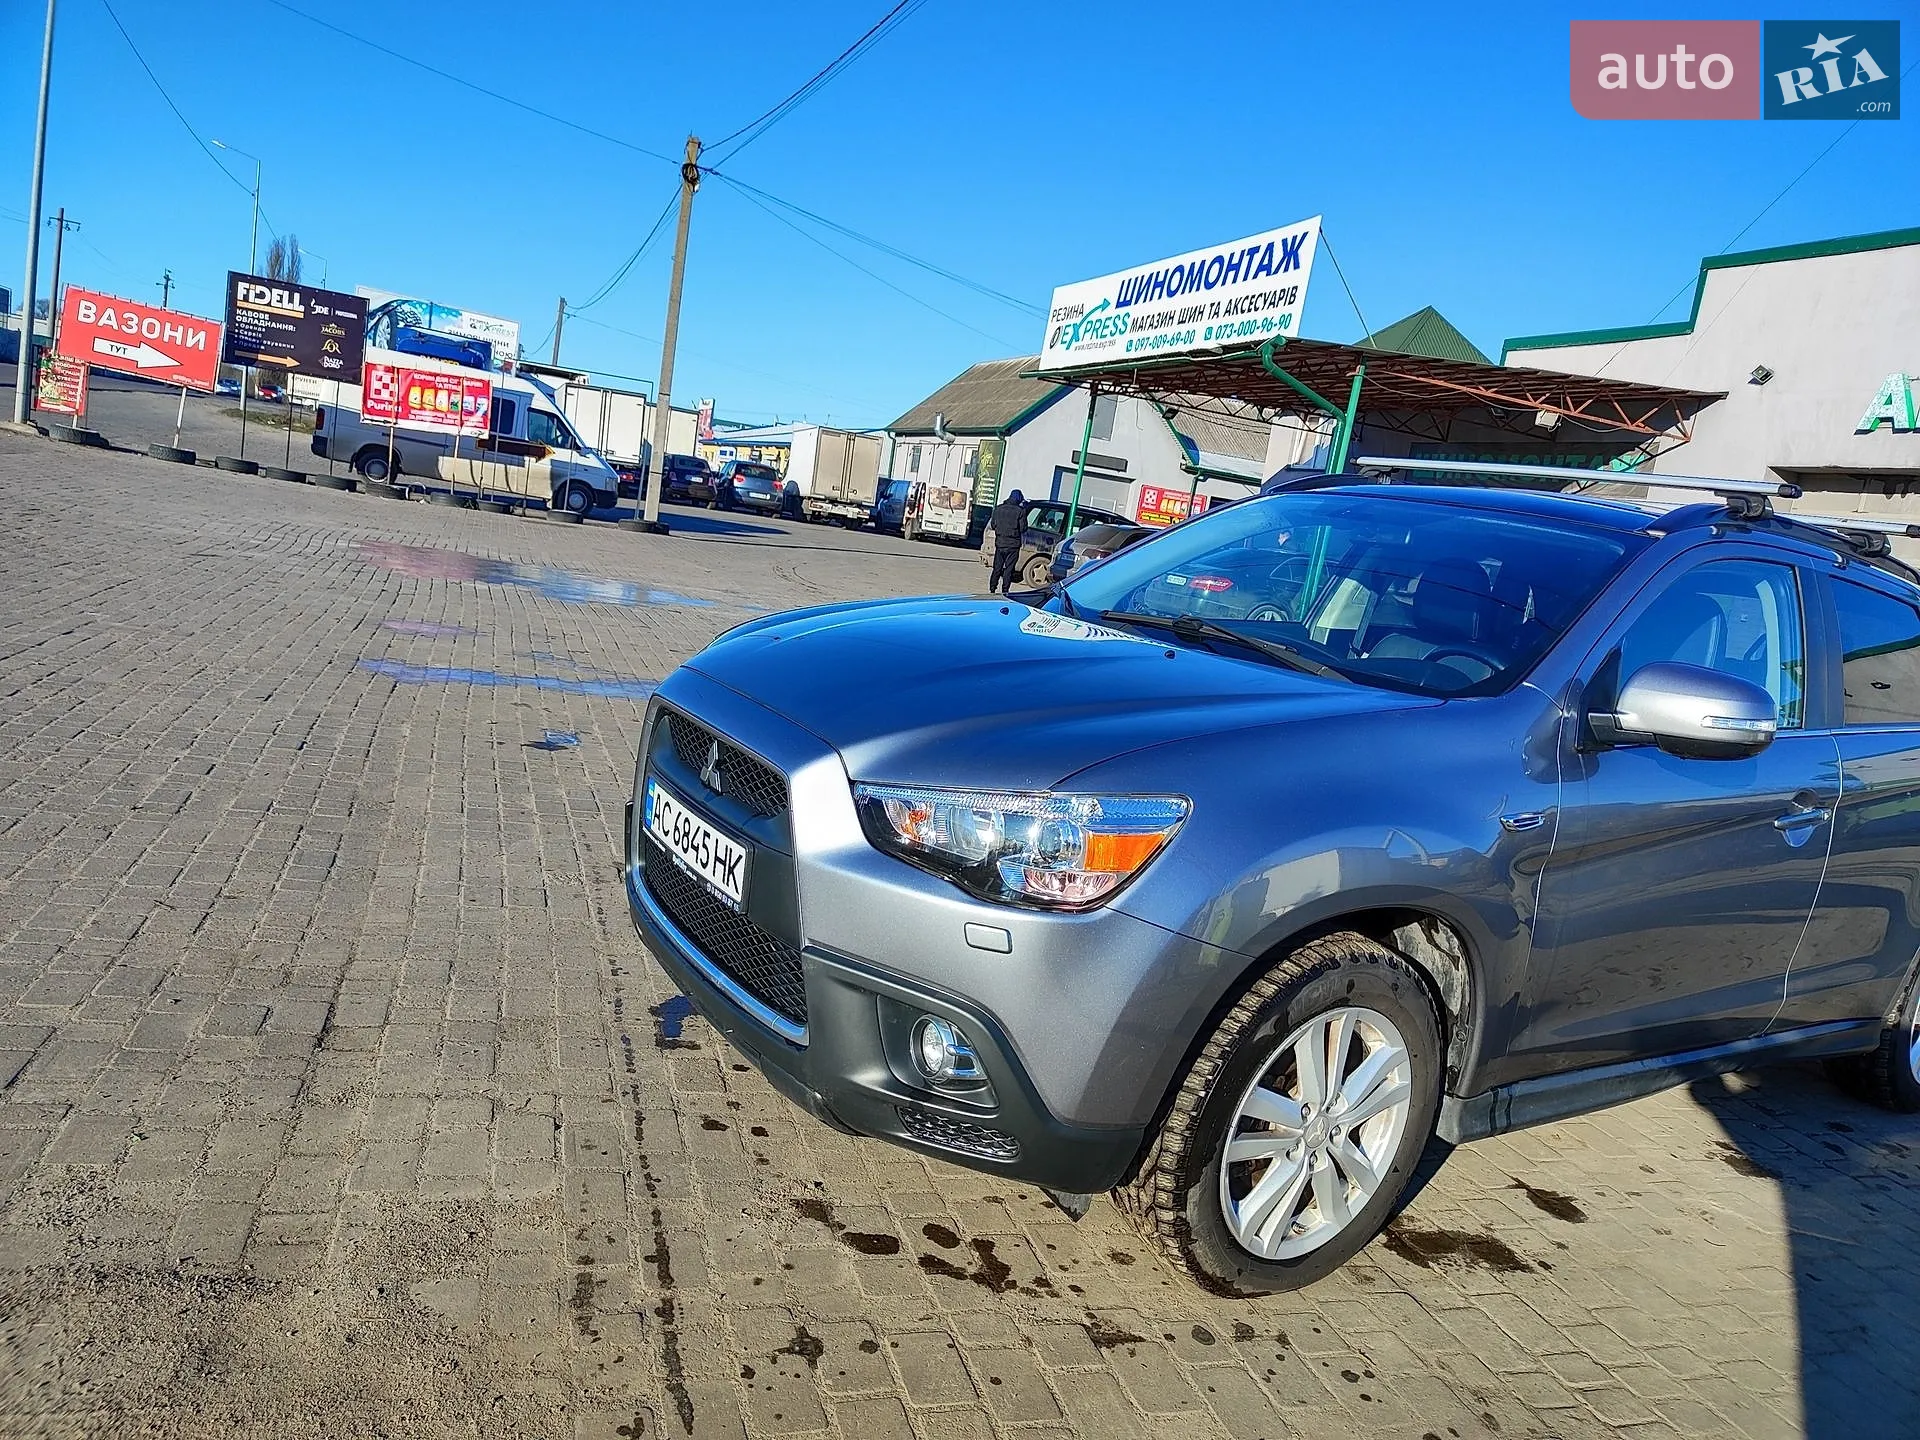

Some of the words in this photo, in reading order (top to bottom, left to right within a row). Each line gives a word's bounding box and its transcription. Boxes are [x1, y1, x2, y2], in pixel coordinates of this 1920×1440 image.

[1115, 231, 1309, 309] ШИНОМОНТАЖ
[77, 299, 207, 351] ВАЗОНИ
[236, 308, 270, 320] КАВОВЕ
[1051, 303, 1084, 322] РЕЗИНА
[1129, 314, 1175, 333] МАГАЗИН
[1177, 306, 1204, 325] ШИН
[1208, 303, 1221, 320] ТА
[1224, 285, 1298, 317] АКСЕСУАРІВ
[109, 343, 128, 355] ТУТ
[1060, 312, 1130, 350] EXPRESS
[1134, 329, 1196, 352] 097-009-69-00
[1215, 312, 1292, 340] 073-000-96-90
[653, 793, 672, 837] AC
[673, 811, 711, 870] 6845
[713, 838, 743, 895] HK
